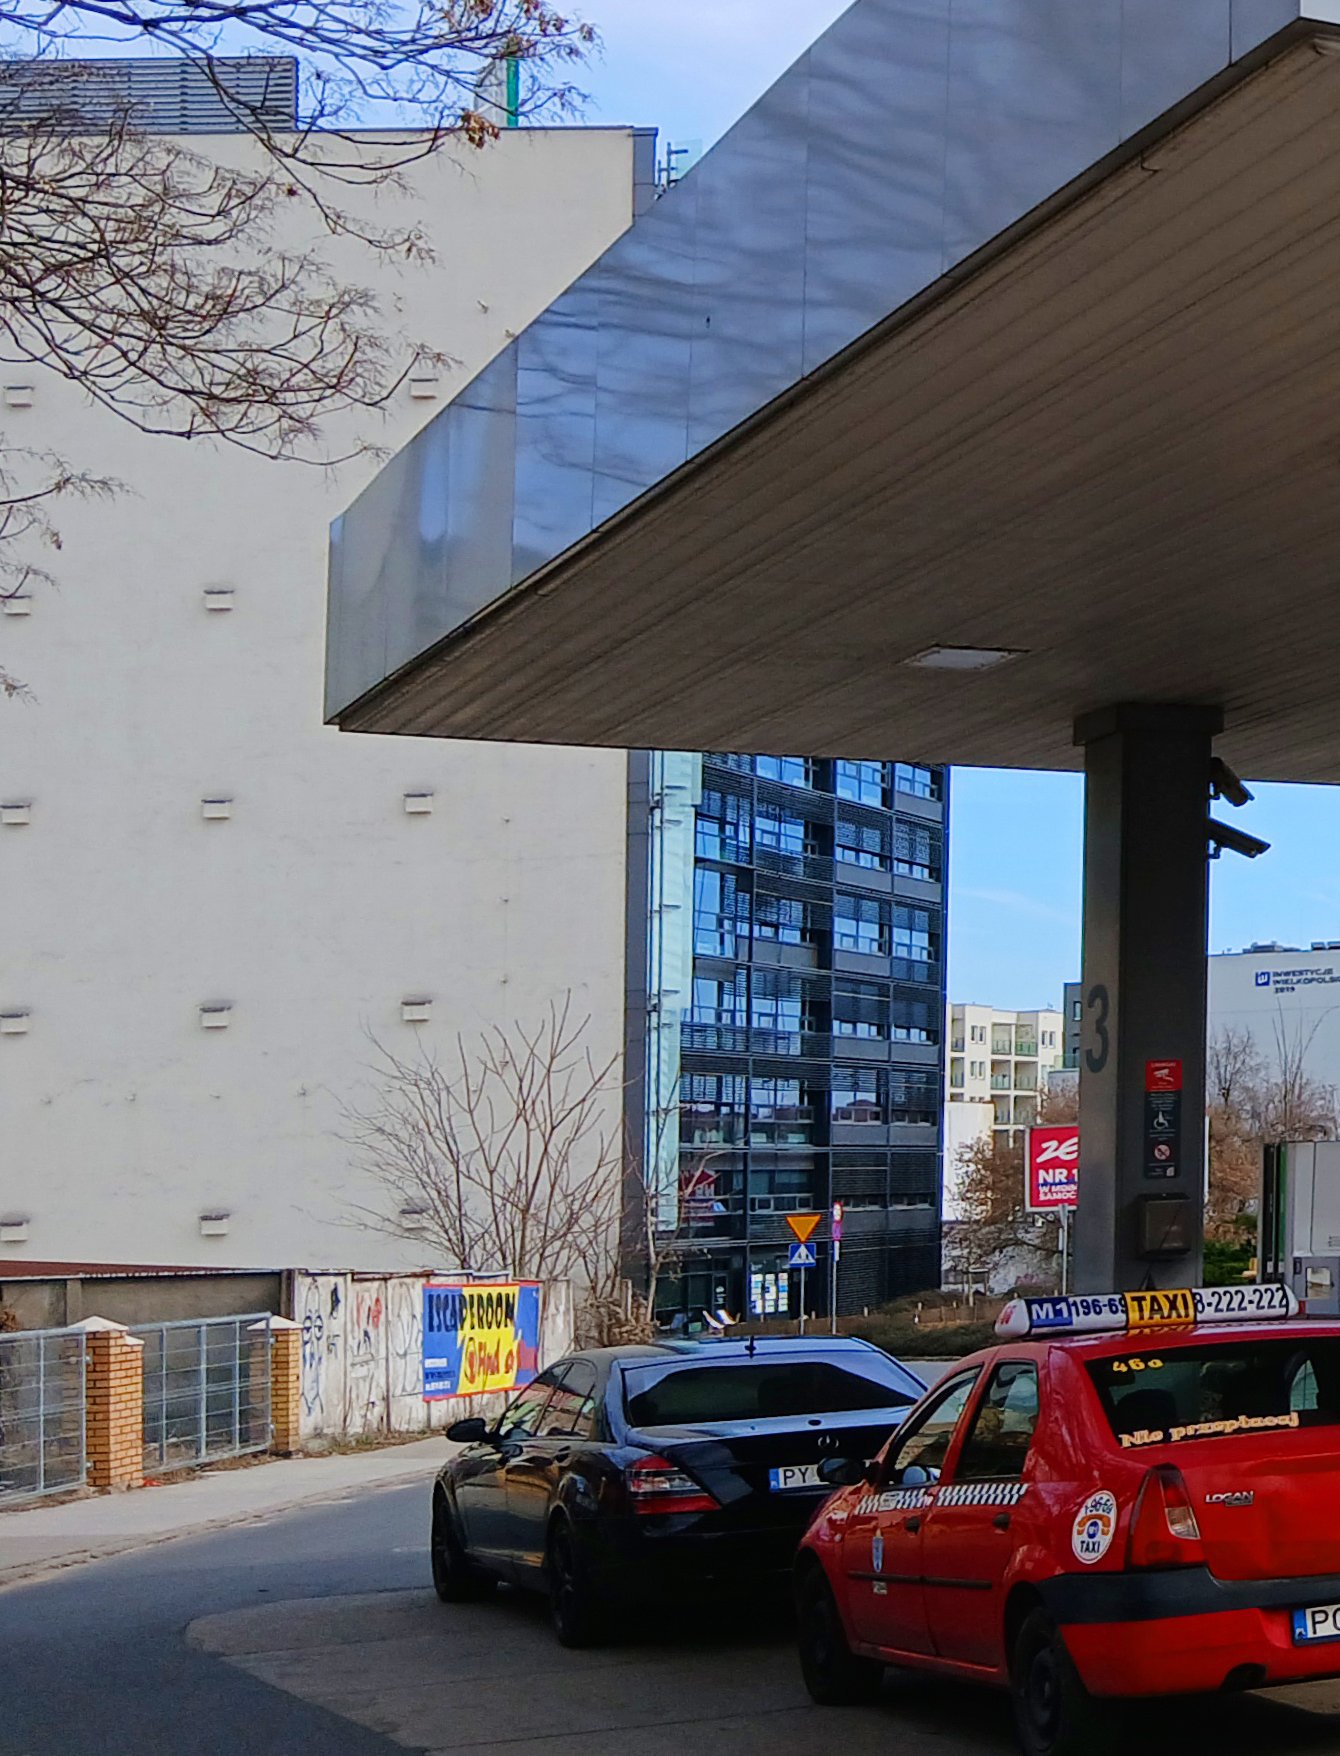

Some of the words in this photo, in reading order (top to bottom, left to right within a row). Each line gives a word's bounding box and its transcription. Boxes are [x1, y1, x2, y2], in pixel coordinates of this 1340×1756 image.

[1086, 984, 1109, 1073] 3
[1039, 1168, 1069, 1184] NR
[1131, 1293, 1191, 1321] TAXI
[1119, 1429, 1164, 1447] Nie
[784, 1467, 810, 1486] PY
[1080, 1540, 1101, 1553] TAXI
